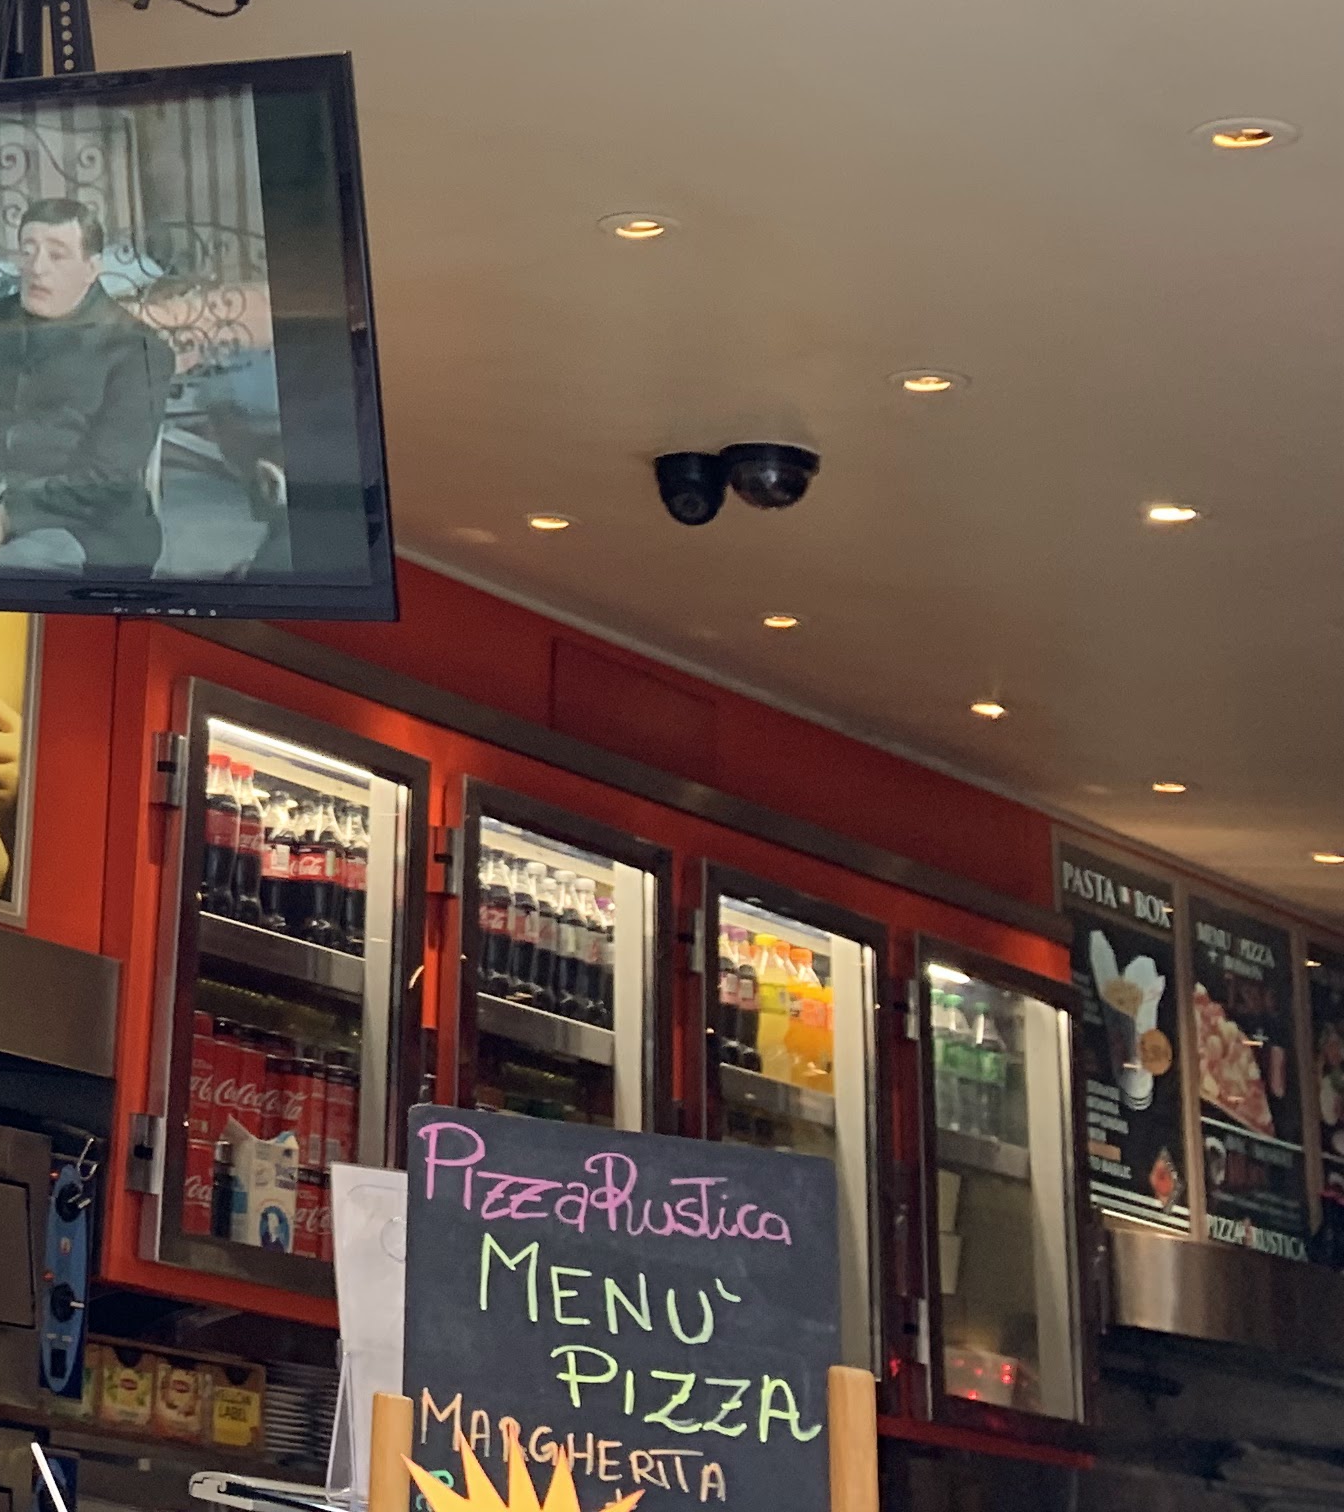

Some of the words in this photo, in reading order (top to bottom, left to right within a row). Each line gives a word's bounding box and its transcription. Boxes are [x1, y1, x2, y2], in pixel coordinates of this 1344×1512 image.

[1063, 860, 1118, 910] PASTA
[1134, 890, 1171, 929] BOX
[551, 1345, 822, 1443] PIZZA
[420, 1386, 728, 1504] MARGHERITA
